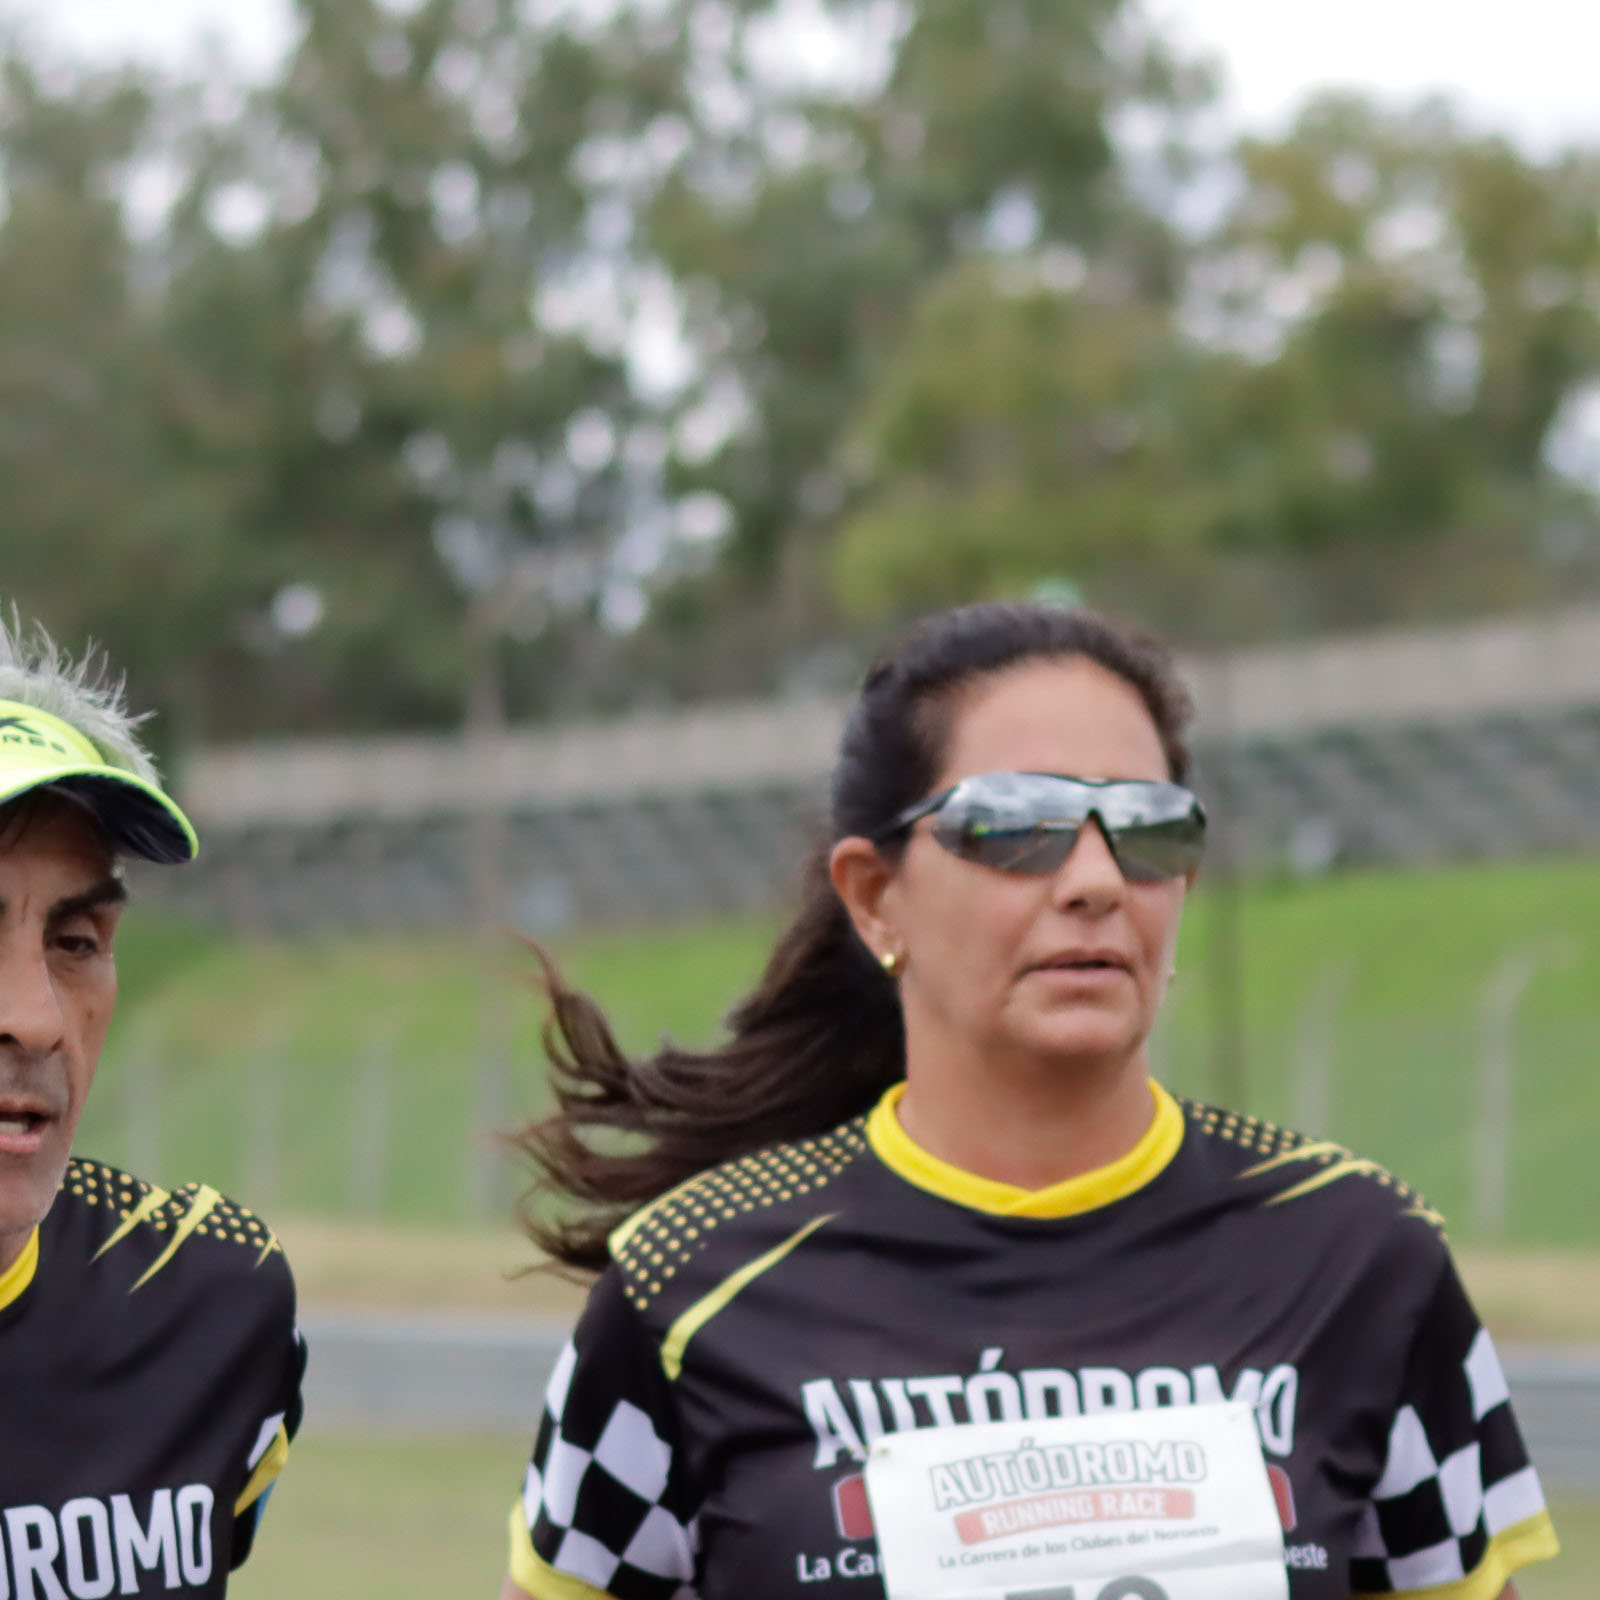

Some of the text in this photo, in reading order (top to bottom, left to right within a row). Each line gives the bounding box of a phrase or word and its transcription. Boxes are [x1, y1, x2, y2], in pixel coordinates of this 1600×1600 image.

[929, 1437, 1208, 1512] AUTÓDROMO
[980, 1489, 1168, 1537] RUNNING RACE
[797, 1553, 832, 1583] La
[938, 1524, 1220, 1570] La Carrera de los Clubes del Noroeste
